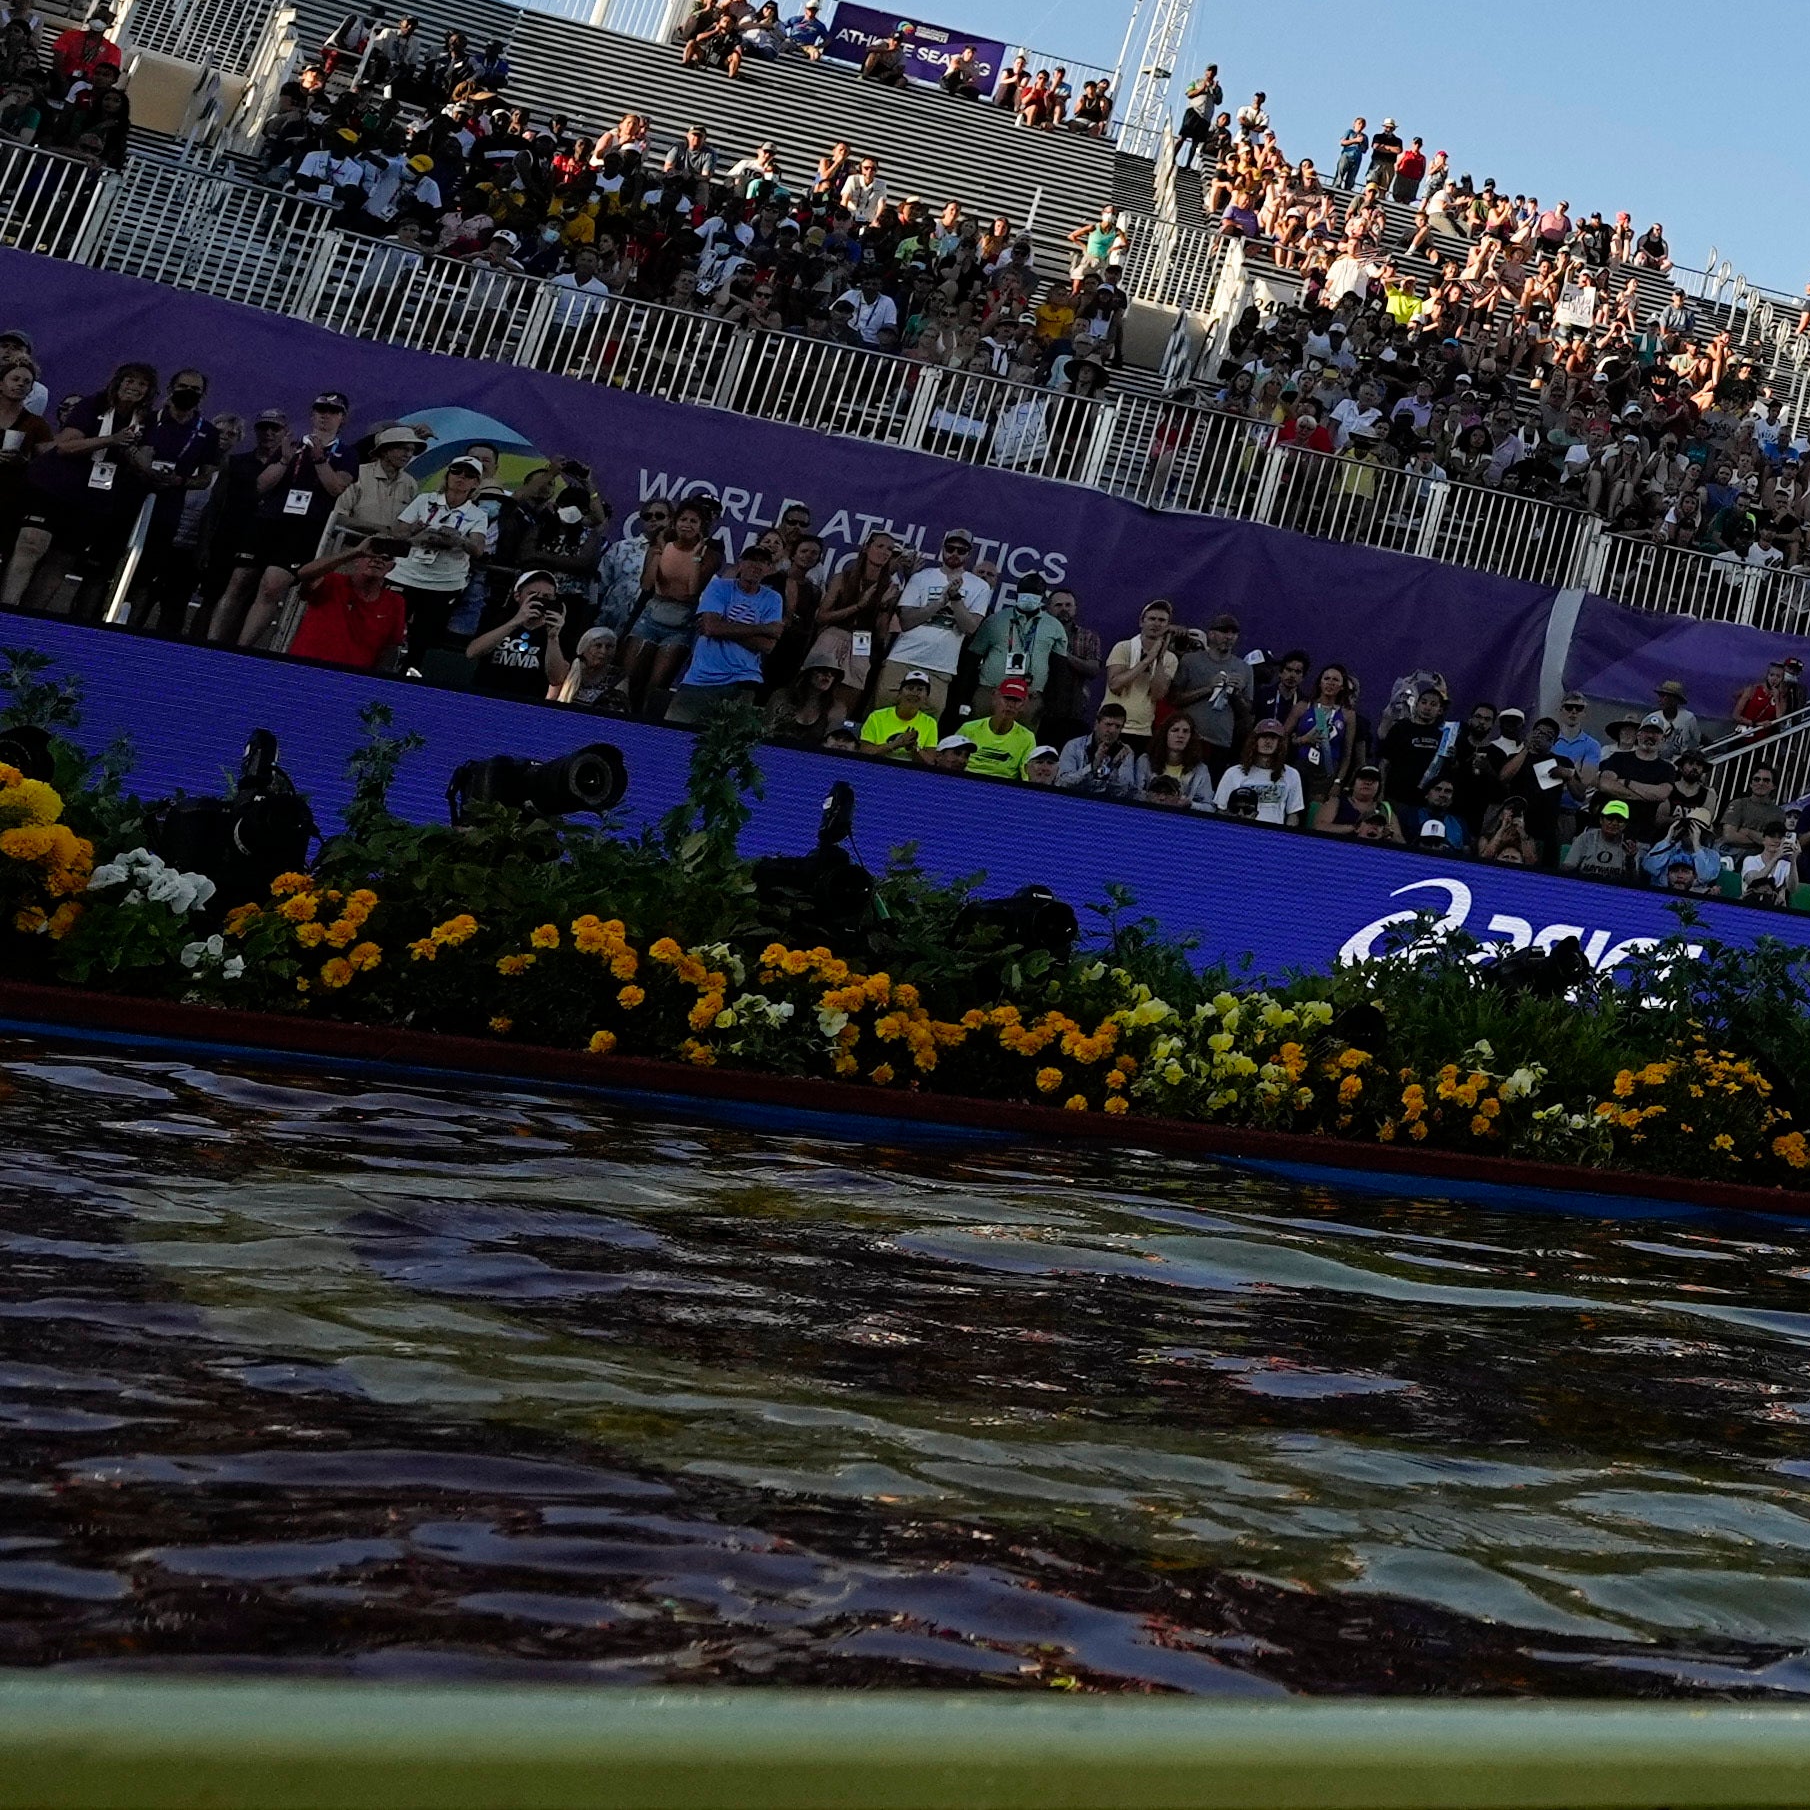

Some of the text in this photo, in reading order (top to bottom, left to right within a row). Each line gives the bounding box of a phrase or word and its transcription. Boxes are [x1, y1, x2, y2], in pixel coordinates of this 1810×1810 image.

[834, 28, 915, 58] ATHE
[916, 46, 991, 77] SEAG
[816, 509, 1068, 585] ATHLTICS
[489, 650, 540, 670] EMMA
